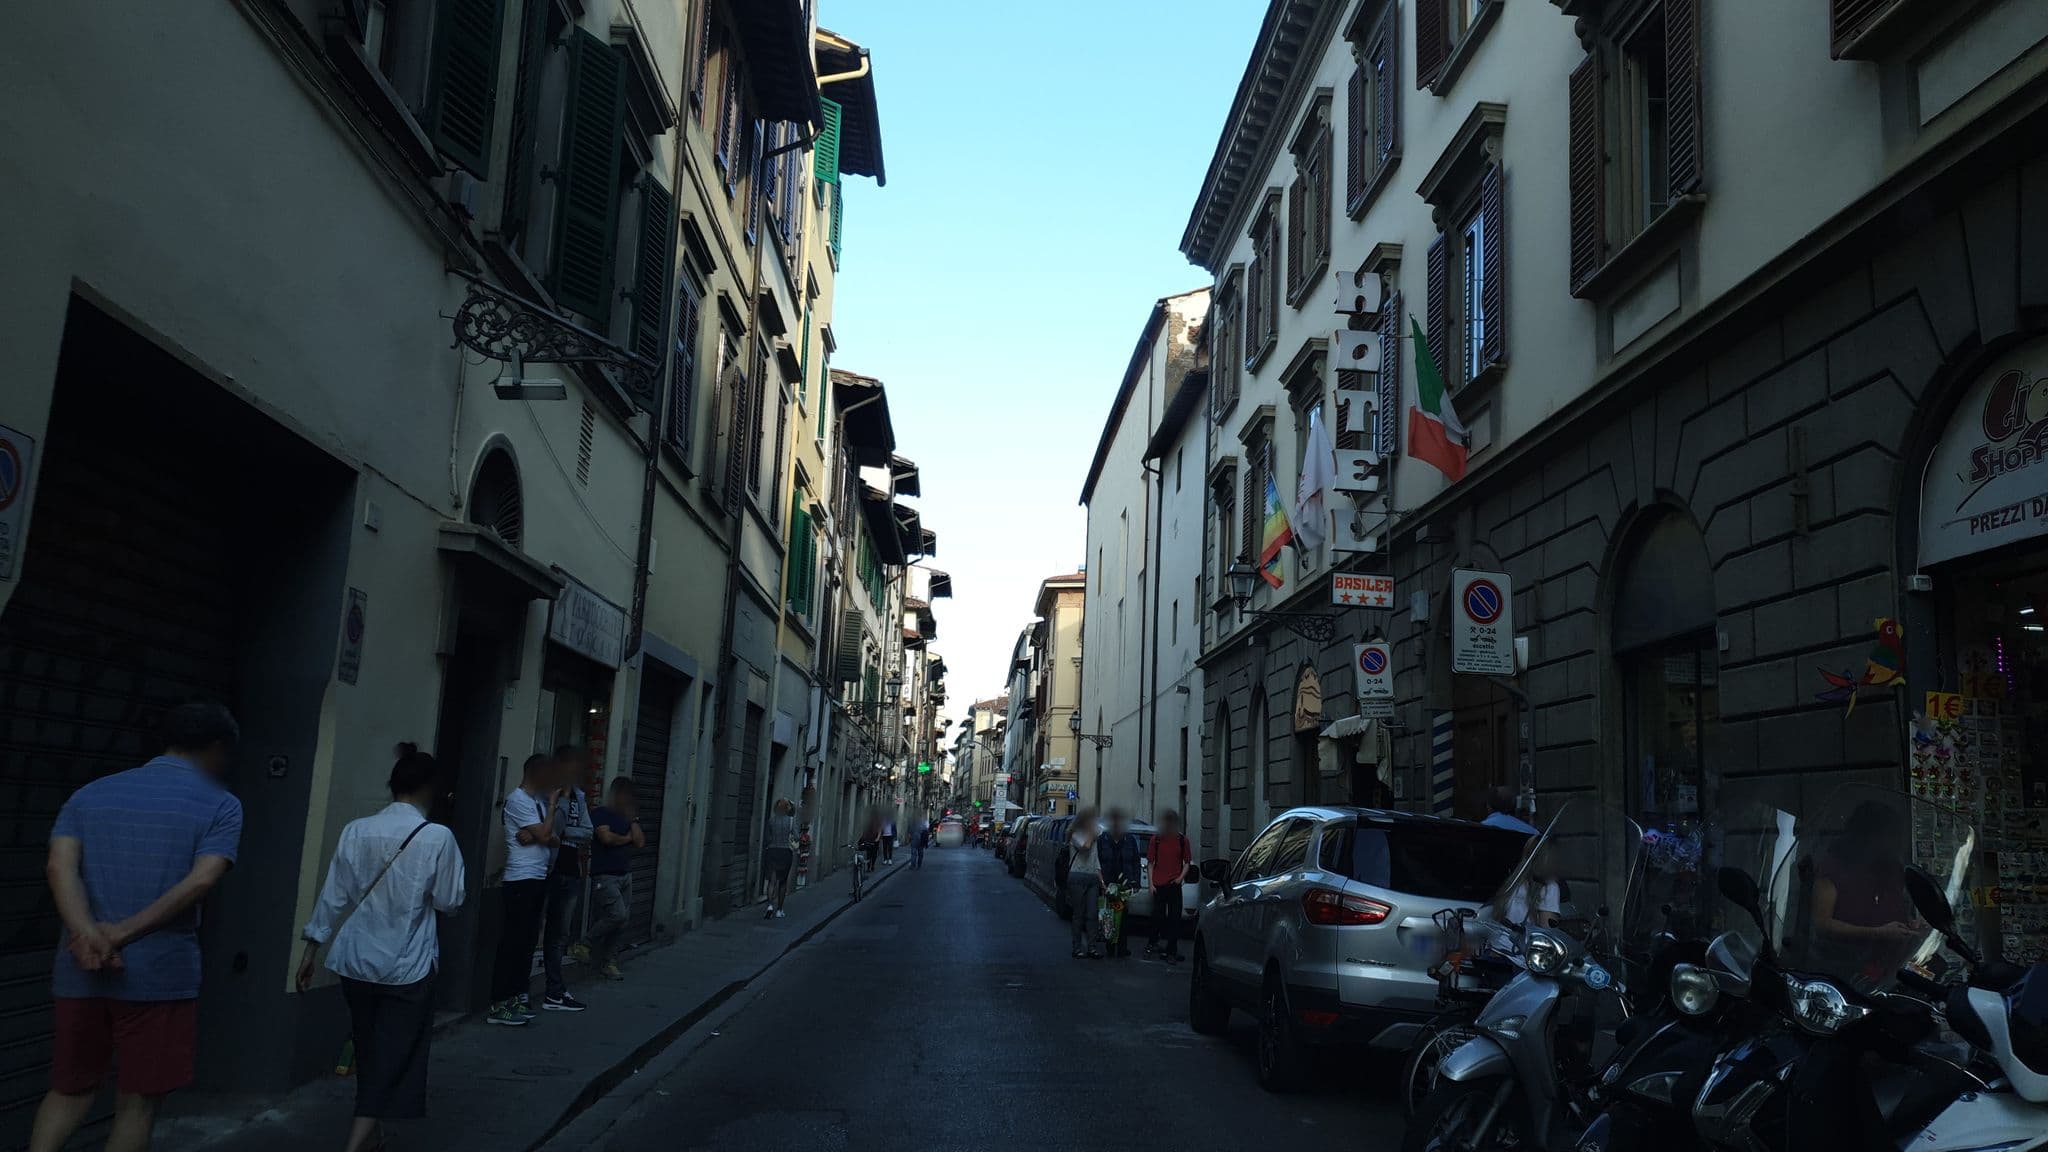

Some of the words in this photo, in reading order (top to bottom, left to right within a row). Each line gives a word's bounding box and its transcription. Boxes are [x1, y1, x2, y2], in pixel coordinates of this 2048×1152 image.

[1331, 270, 1382, 553] HOTEL
[1970, 502, 2026, 535] PREZZI
[1335, 576, 1393, 592] BASILEA
[1479, 626, 1497, 635] 0-24
[1928, 694, 1961, 719] 1€
